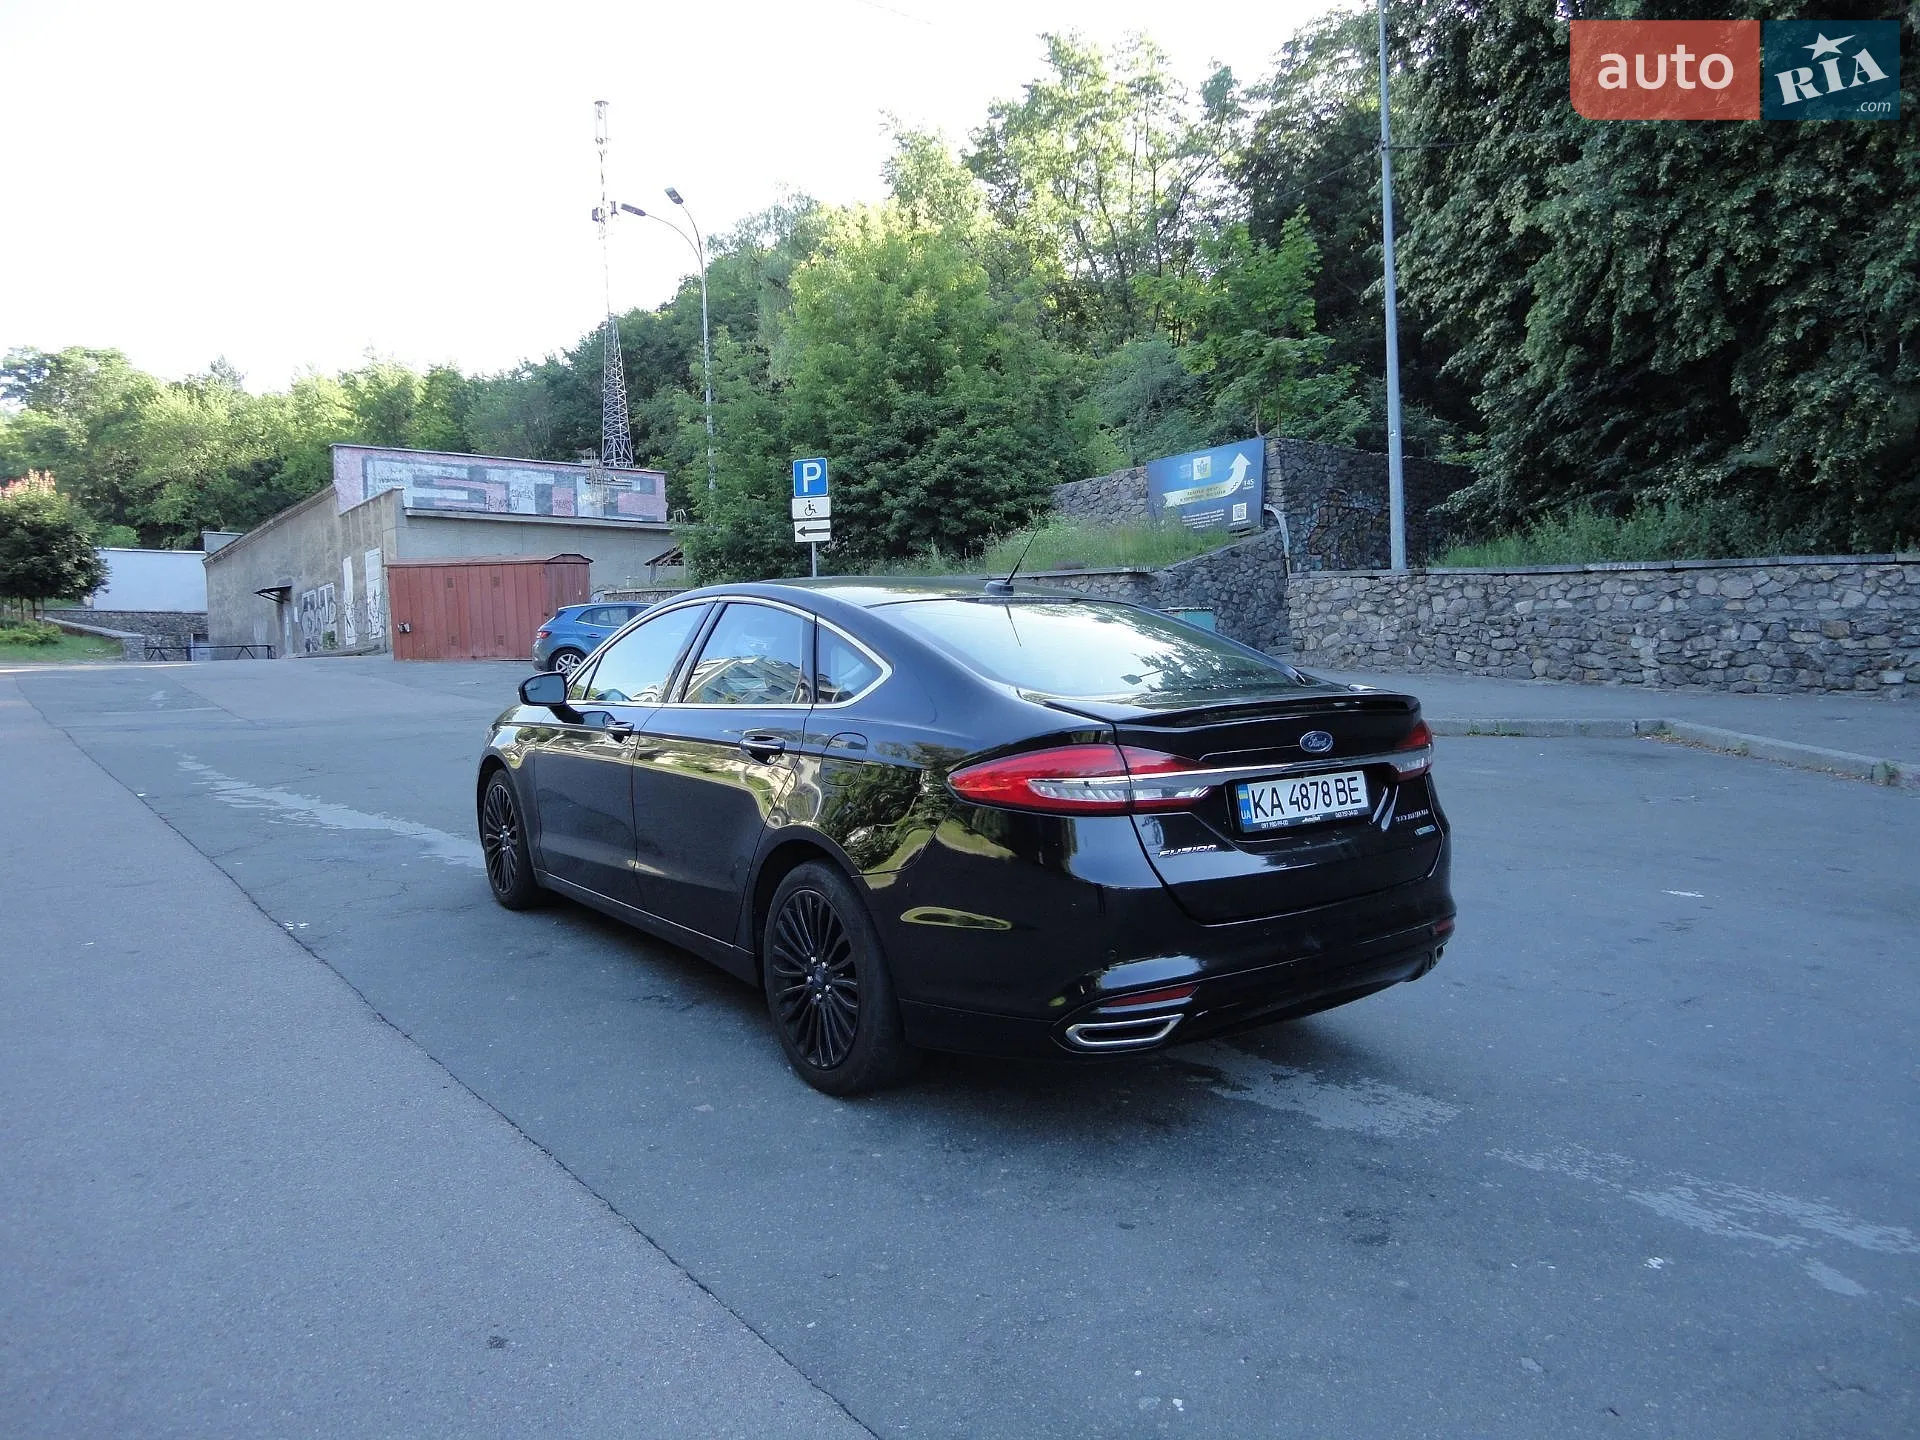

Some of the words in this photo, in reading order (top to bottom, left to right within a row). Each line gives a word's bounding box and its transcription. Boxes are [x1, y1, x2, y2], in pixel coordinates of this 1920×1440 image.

[803, 462, 822, 493] P
[1252, 787, 1285, 819] KA
[1289, 780, 1333, 813] 4878
[1335, 776, 1362, 806] BE
[1241, 809, 1252, 820] UA
